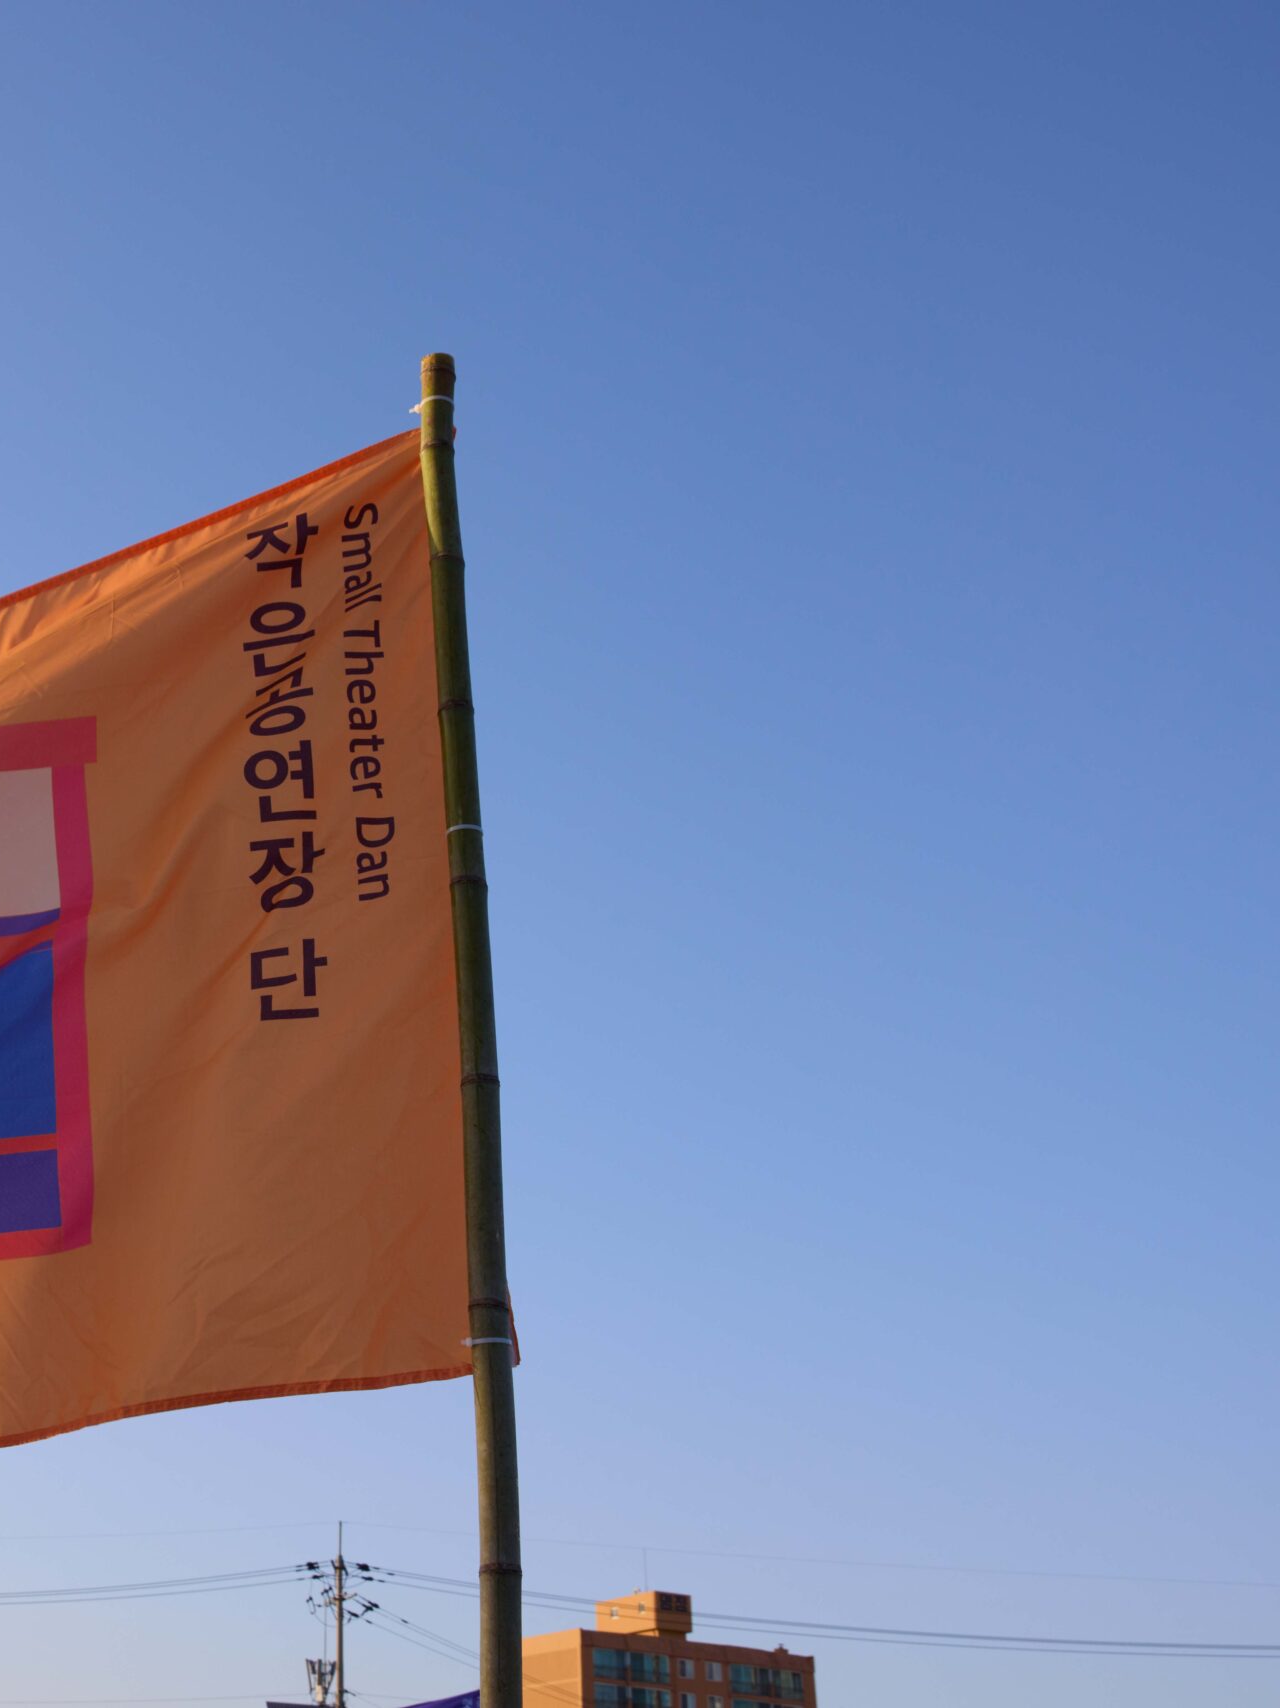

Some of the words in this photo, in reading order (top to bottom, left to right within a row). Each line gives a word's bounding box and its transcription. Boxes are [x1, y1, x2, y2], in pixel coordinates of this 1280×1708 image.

[342, 502, 383, 613] Small
[242, 512, 326, 913] 작은공연장
[343, 619, 385, 799] Theater
[355, 816, 396, 902] Dan
[250, 938, 328, 1021] 단
